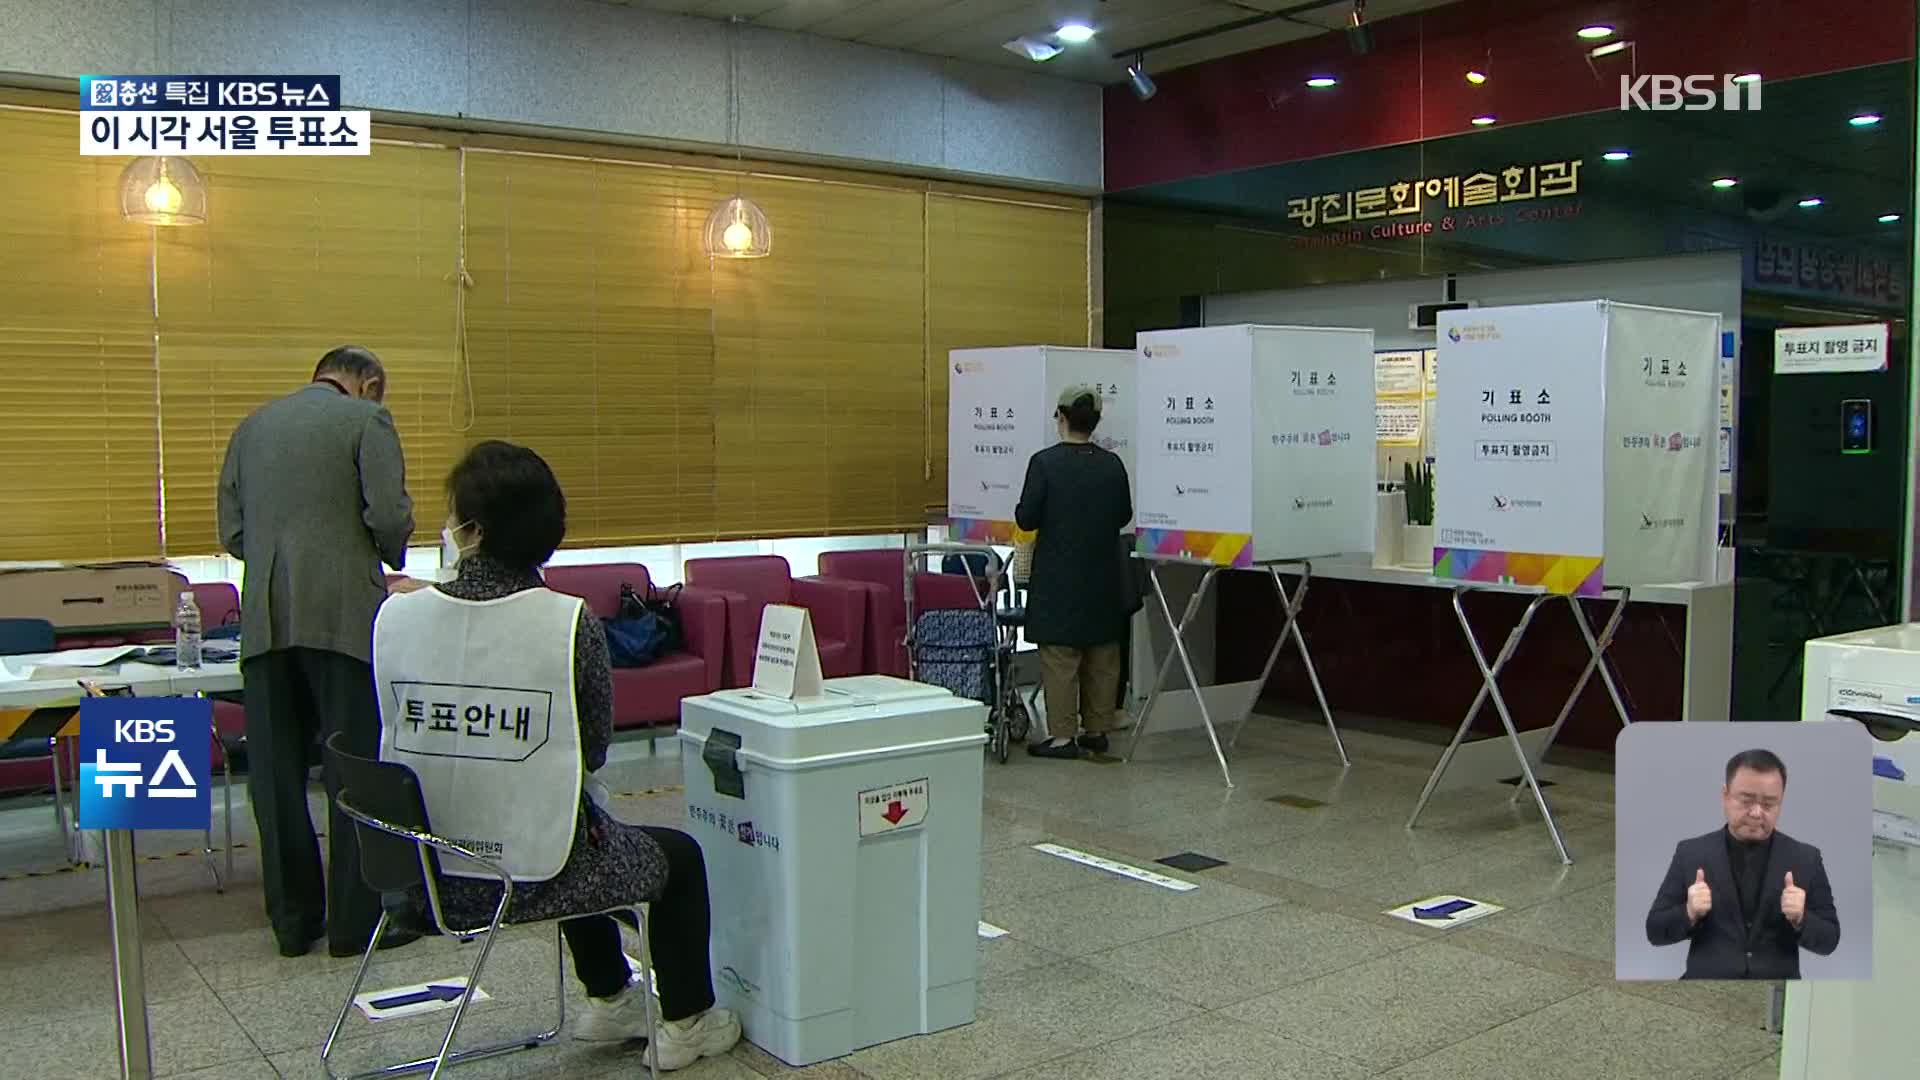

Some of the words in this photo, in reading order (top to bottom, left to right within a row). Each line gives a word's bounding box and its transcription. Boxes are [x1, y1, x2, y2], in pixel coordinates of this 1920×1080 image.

[1288, 160, 1583, 228] 광진문화예술회관
[1371, 220, 1432, 240] Culture
[1441, 217, 1456, 231] &
[1784, 340, 1820, 355] 투표지
[1824, 339, 1849, 355] 촬영
[1852, 338, 1878, 353] 금지
[1481, 413, 1517, 423] POLLING
[1520, 412, 1551, 423] BOOTH
[1482, 444, 1509, 457] 투표지
[405, 698, 531, 742] 투표안내
